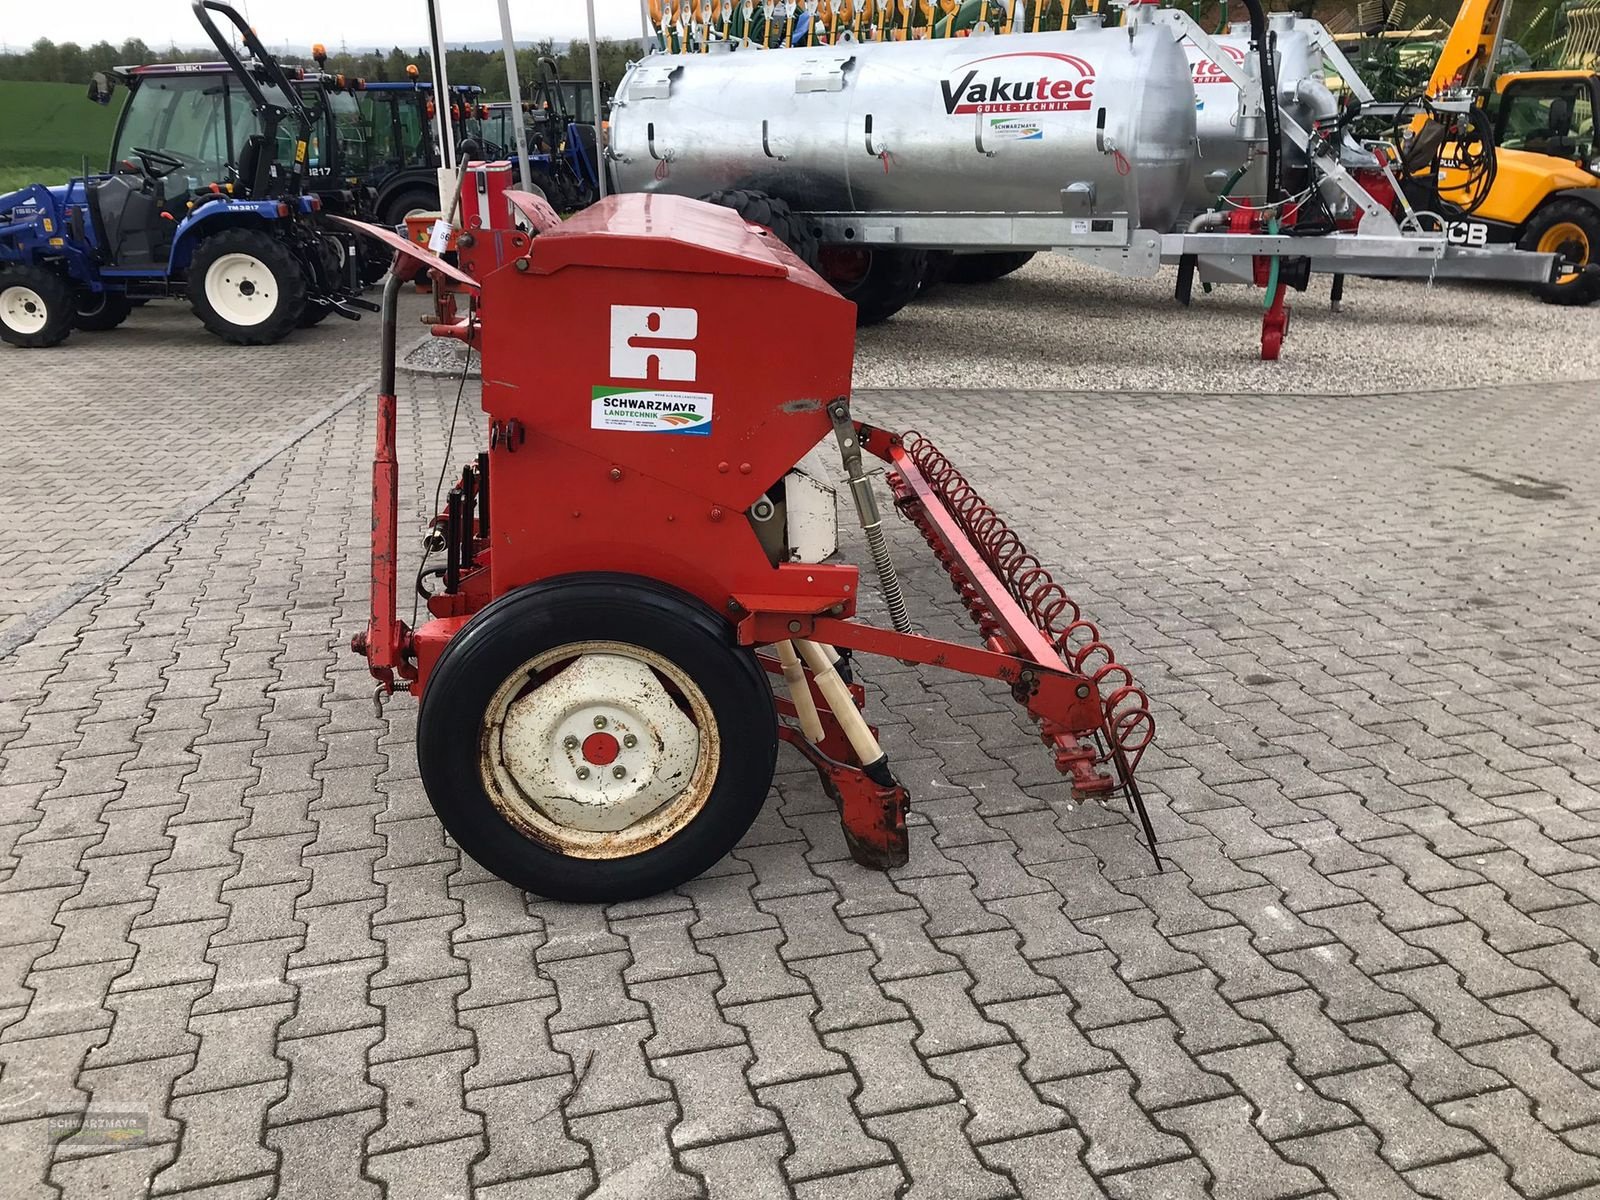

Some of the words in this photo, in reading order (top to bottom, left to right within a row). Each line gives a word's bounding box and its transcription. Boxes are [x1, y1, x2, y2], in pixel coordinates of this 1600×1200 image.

[940, 70, 1095, 114] Vakutec
[976, 101, 1069, 113] GÜLLE-TECHNIK
[603, 398, 696, 412] SCHWARZMAYR
[604, 409, 658, 419] LANDTECHNIK
